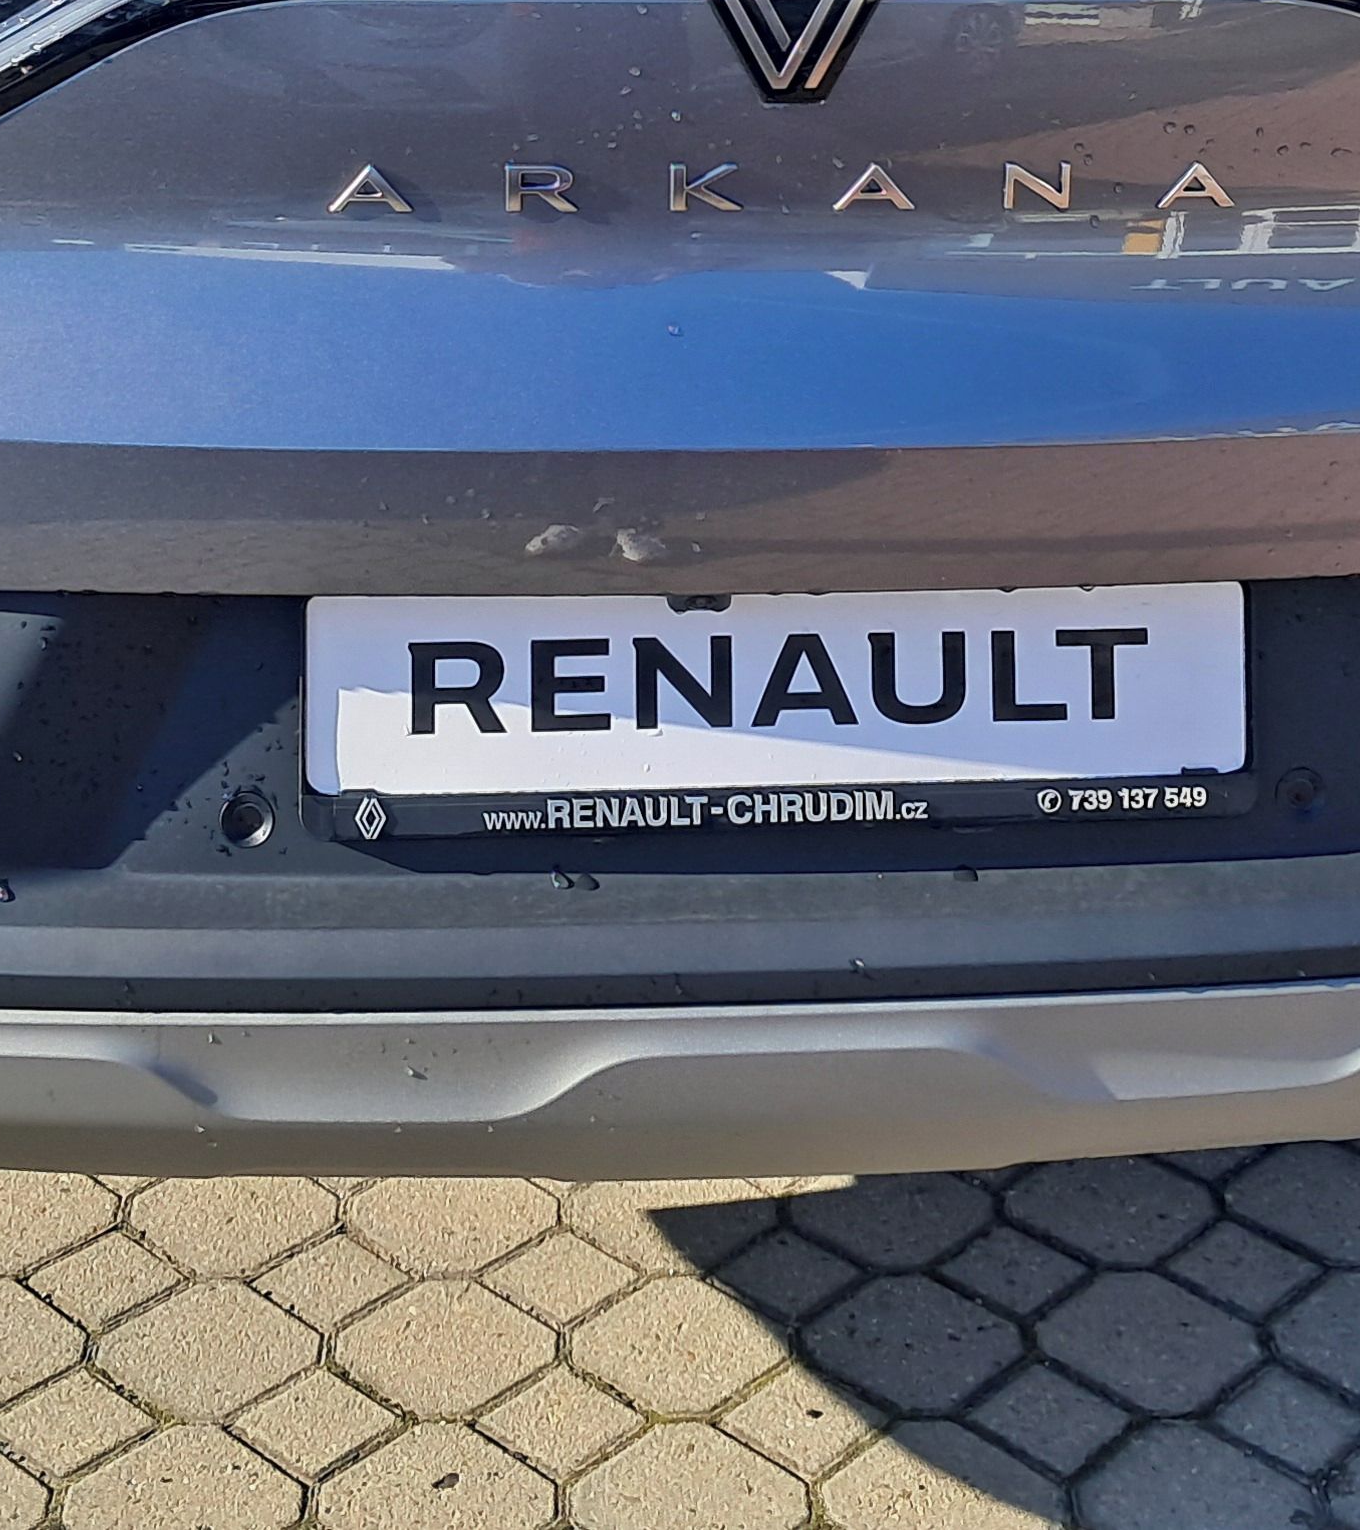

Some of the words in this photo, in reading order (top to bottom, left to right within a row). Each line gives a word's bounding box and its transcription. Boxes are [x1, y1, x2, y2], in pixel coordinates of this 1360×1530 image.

[327, 160, 1236, 213] ARKANA
[407, 627, 1149, 736] RENAULT
[482, 790, 930, 831] www.RENAULT-CHRUDIM.cz
[1068, 789, 1113, 811] 739
[1118, 788, 1159, 809] 137
[1164, 786, 1207, 808] 549
